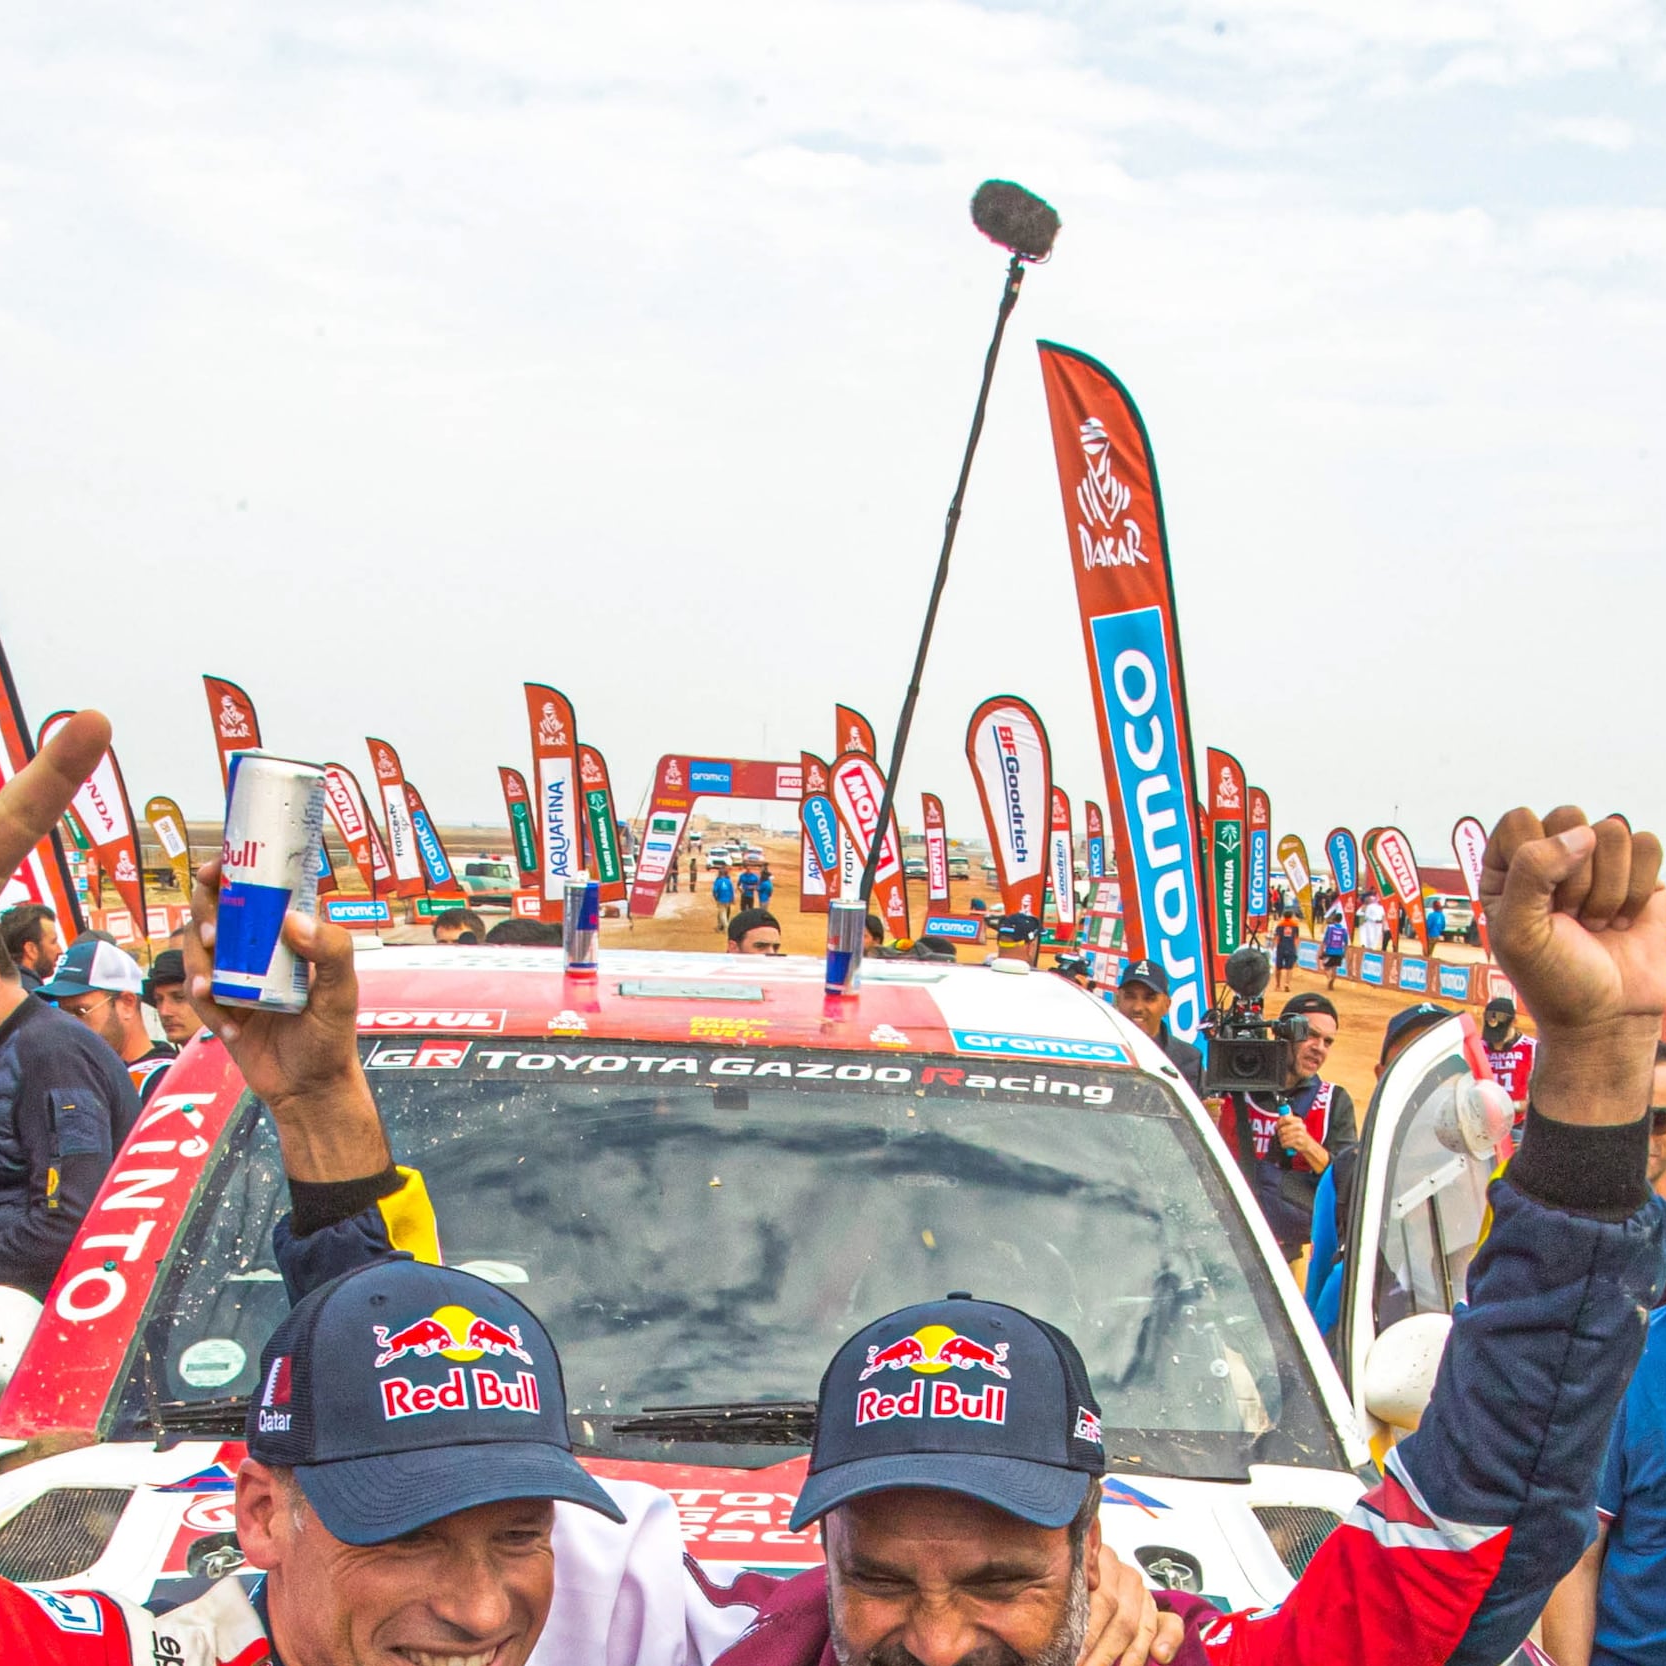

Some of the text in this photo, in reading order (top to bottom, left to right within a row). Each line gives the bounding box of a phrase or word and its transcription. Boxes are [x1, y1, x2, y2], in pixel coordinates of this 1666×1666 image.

[1079, 520, 1149, 570] DAKAR
[691, 772, 730, 783] aramco
[780, 778, 802, 787] MOT
[998, 726, 1028, 863] BFGoodrich
[85, 780, 114, 832] NDA
[327, 773, 362, 834] MOTUL
[550, 779, 571, 878] AQUAFINA
[415, 812, 445, 878] aramco
[812, 800, 835, 863] aramco
[1226, 860, 1235, 902] ARABIA
[1251, 836, 1264, 910] aramco
[1336, 834, 1352, 889] aramco
[1383, 841, 1416, 896] MOTUL
[331, 904, 386, 918] aramco
[929, 922, 975, 934] aramco
[355, 1010, 494, 1032] MOTUL
[962, 1034, 1124, 1059] aramco
[370, 1042, 1115, 1106] GR TOYOTA GAZOO Racing
[382, 1368, 541, 1419] Red Bull
[856, 1380, 1008, 1426] Red Bull
[258, 1409, 292, 1433] Qatar
[663, 1488, 800, 1507] TOY
[680, 1525, 810, 1544] Rac
